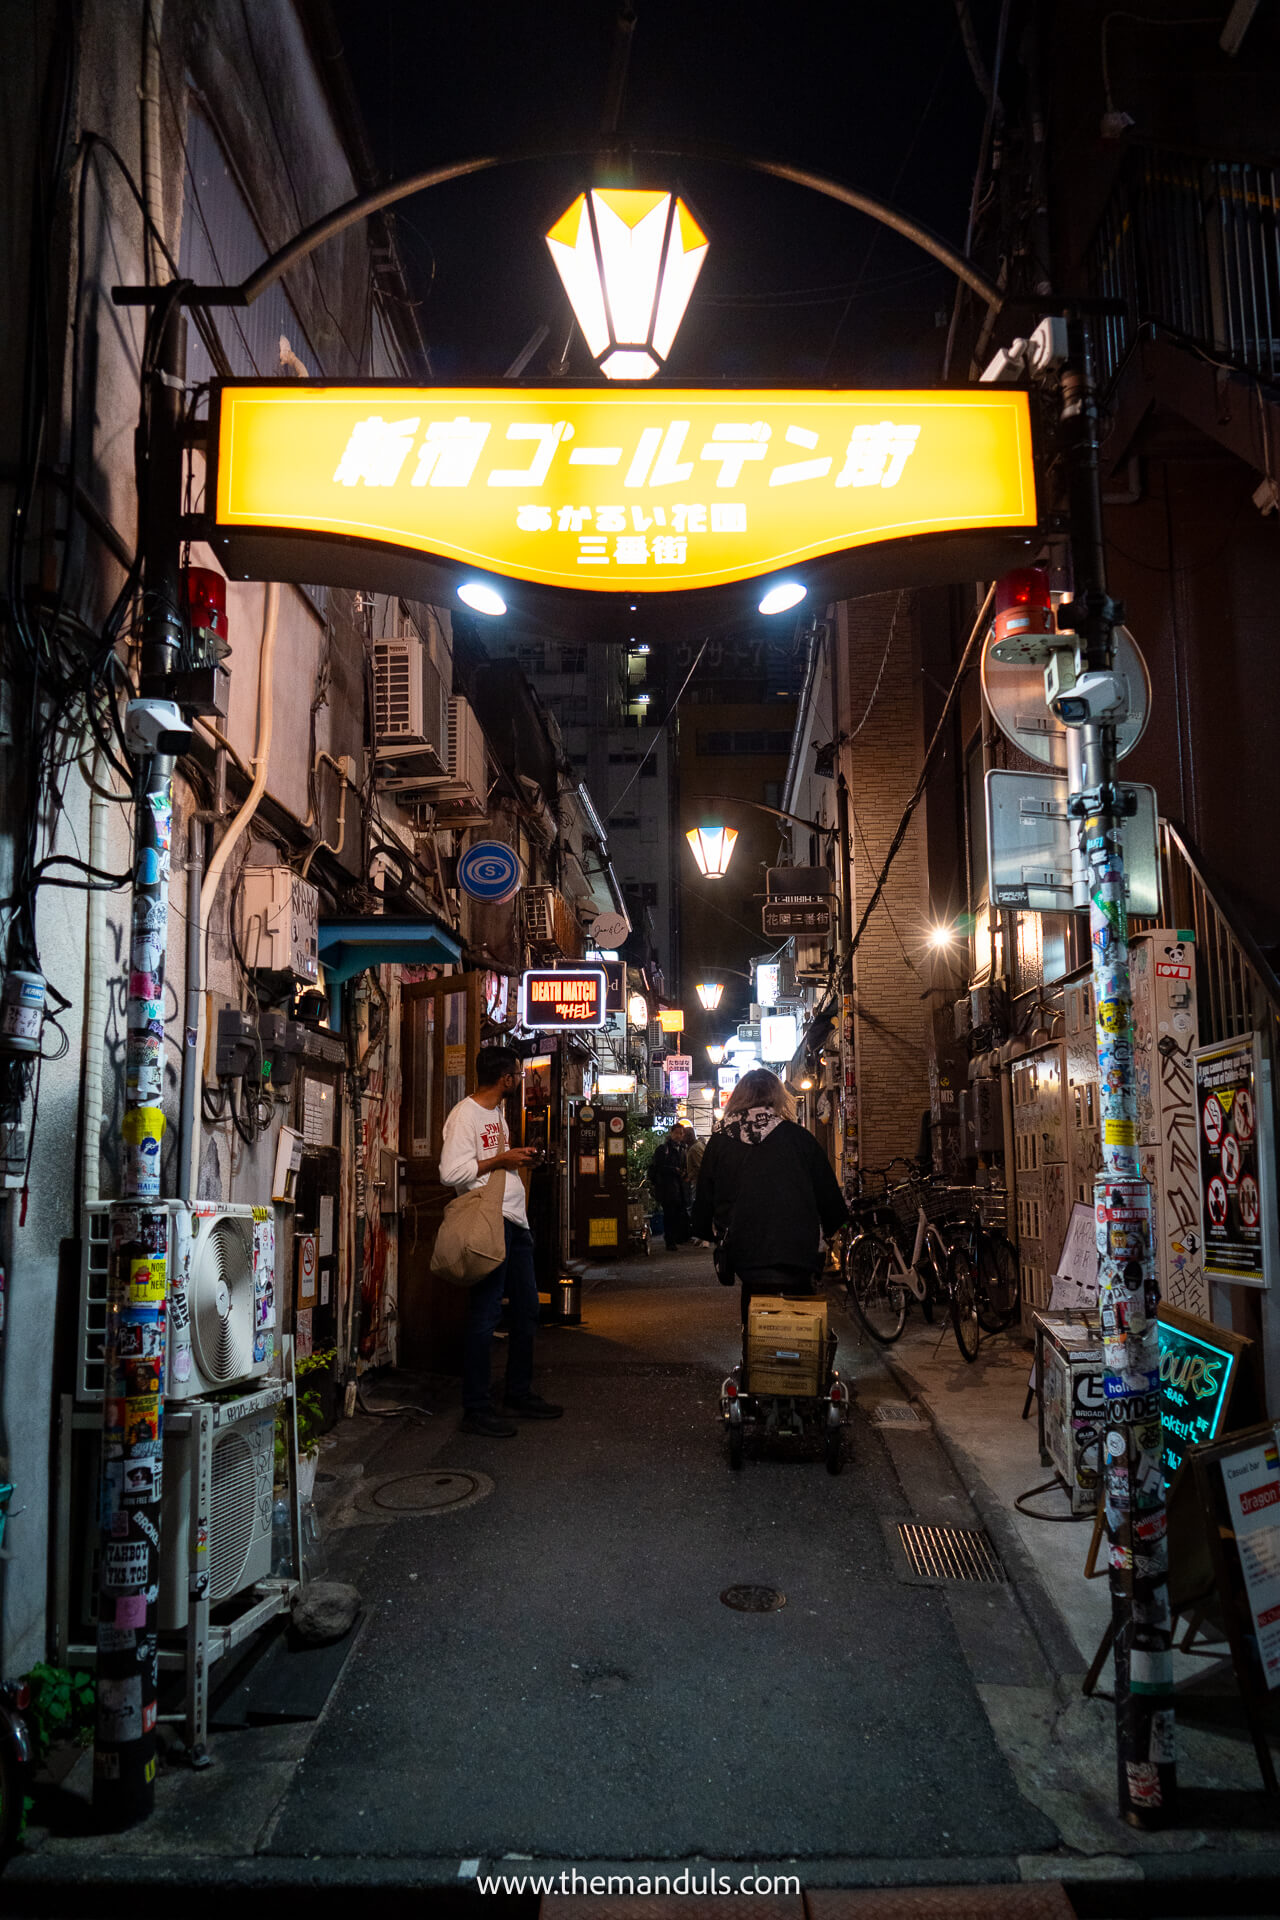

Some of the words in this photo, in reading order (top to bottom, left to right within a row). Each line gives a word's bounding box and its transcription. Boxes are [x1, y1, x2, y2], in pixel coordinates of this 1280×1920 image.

[333, 416, 921, 488] 新宿ゴールデン街
[516, 503, 748, 533] あかるい花園
[577, 535, 688, 565] 三番街
[765, 912, 829, 926] 花園三番街
[531, 981, 562, 1002] DEATH
[563, 981, 597, 1002] MATCH
[563, 1001, 597, 1020] HELL
[1227, 1463, 1249, 1480] Casual
[1249, 1461, 1260, 1472] bar
